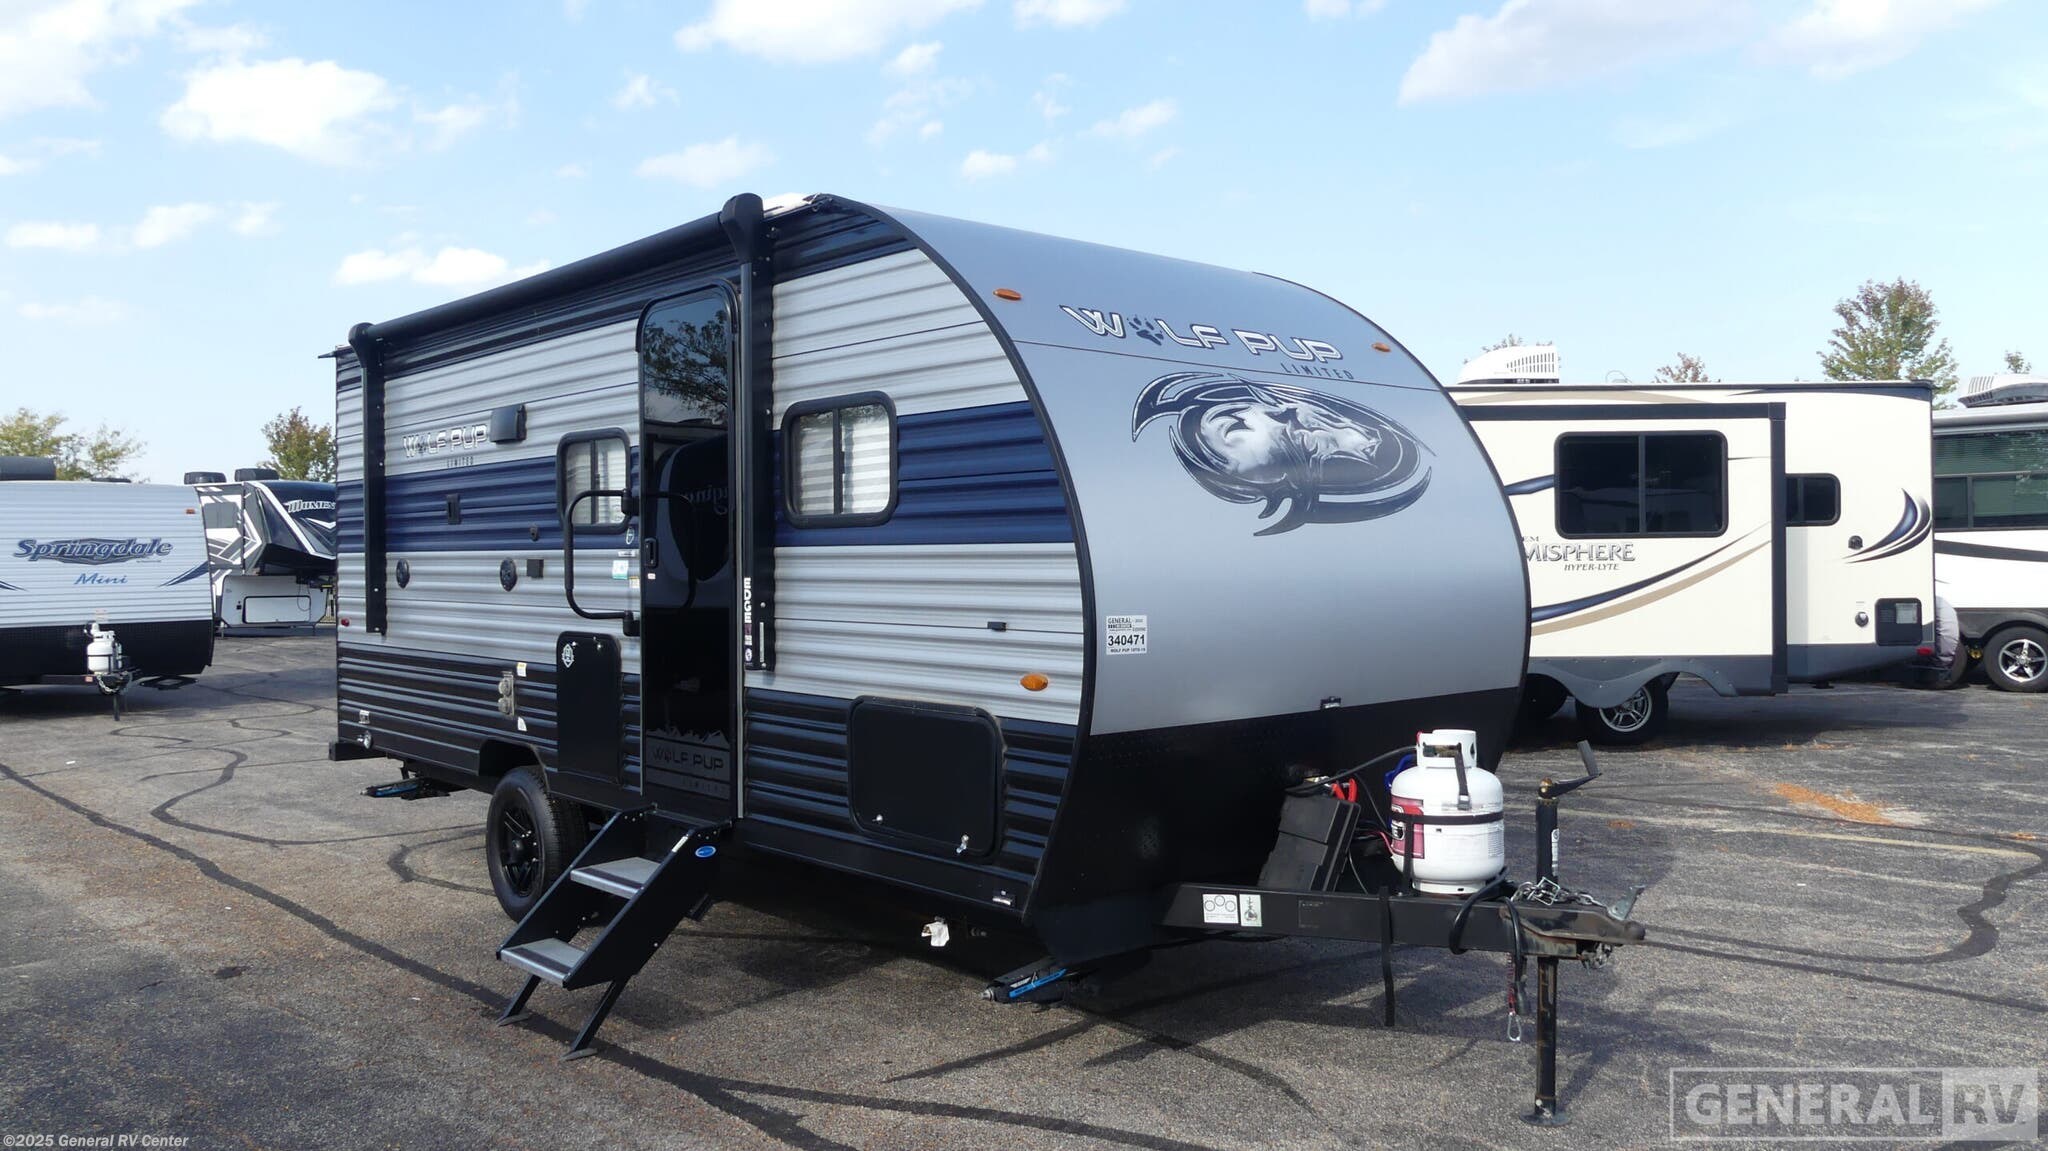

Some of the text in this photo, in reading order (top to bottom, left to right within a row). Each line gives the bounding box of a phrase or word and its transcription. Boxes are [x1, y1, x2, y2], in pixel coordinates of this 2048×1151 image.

[1231, 327, 1344, 364] PUP
[1280, 363, 1354, 380] LIMITED
[450, 423, 488, 452] PUP
[13, 537, 174, 562] Springdale
[1563, 563, 1620, 571] HYPER-LYTE
[74, 573, 129, 585] Mini
[1107, 634, 1145, 646] 340471
[693, 753, 724, 771] PUP
